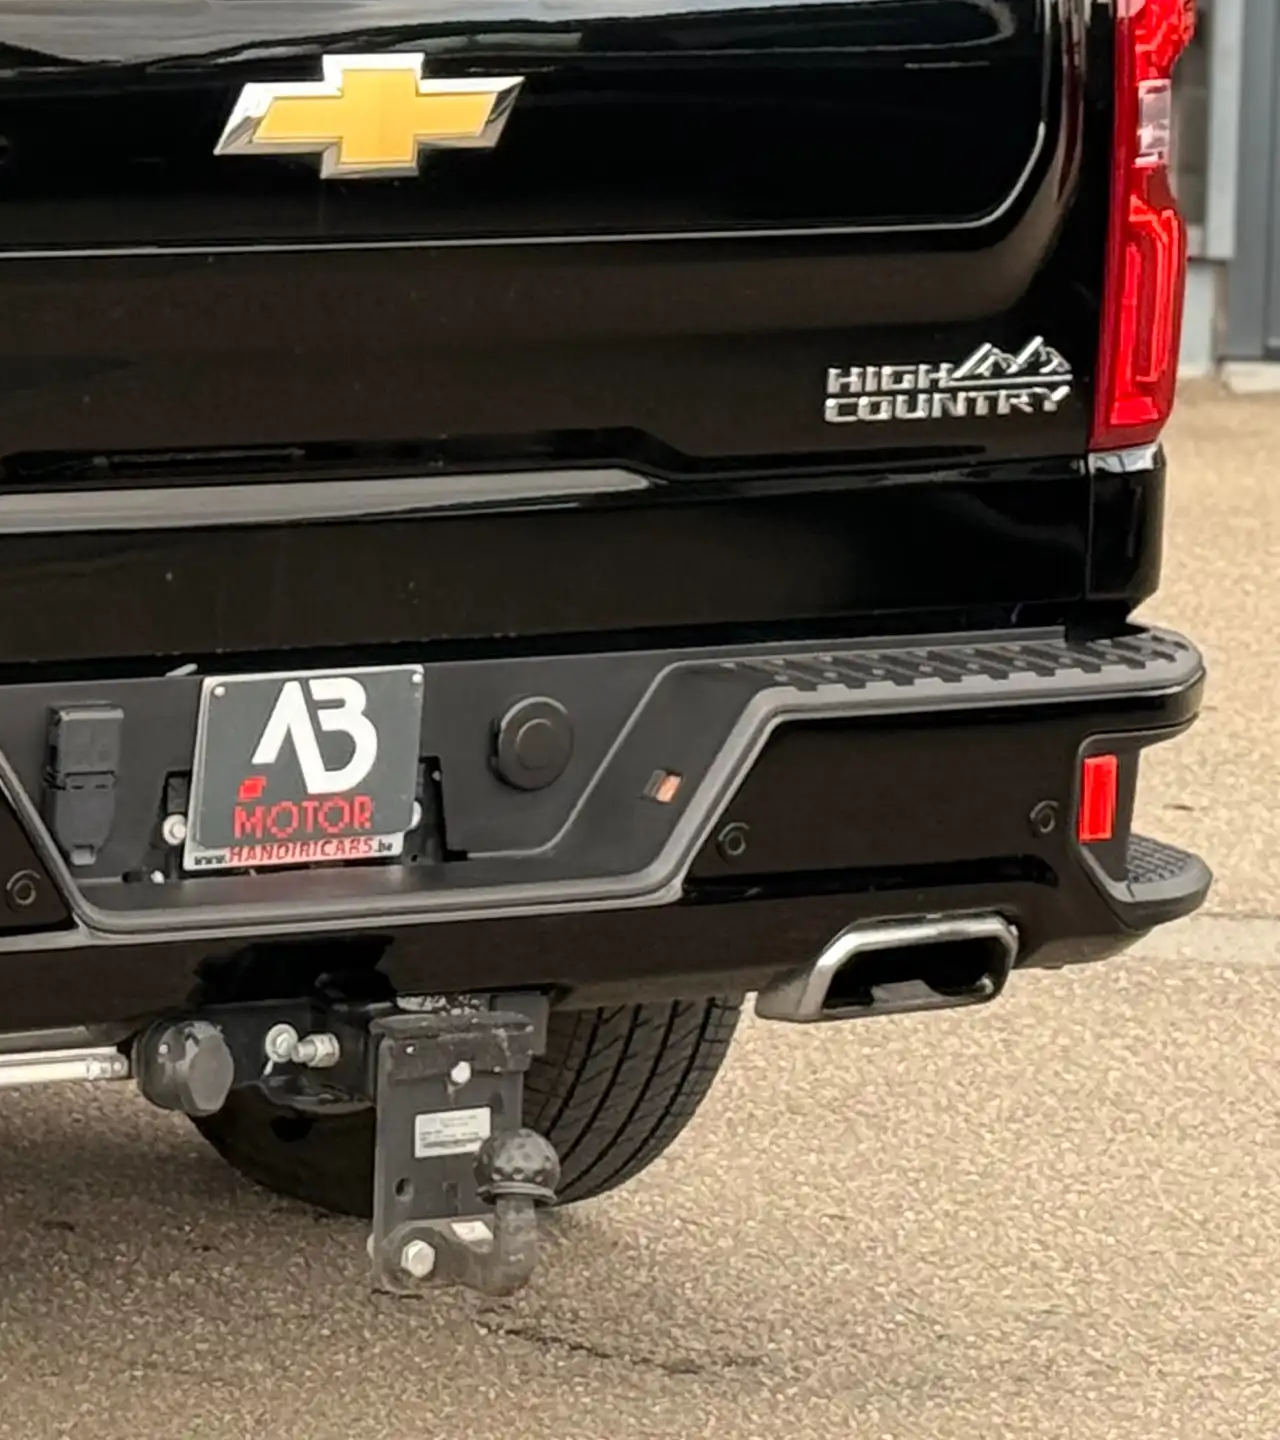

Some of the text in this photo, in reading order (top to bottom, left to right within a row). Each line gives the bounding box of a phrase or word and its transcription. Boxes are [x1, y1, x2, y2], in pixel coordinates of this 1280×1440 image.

[826, 363, 955, 393] HIGH
[824, 385, 1071, 422] COUNTRY
[251, 676, 378, 794] AB
[233, 795, 375, 839] MOTOR
